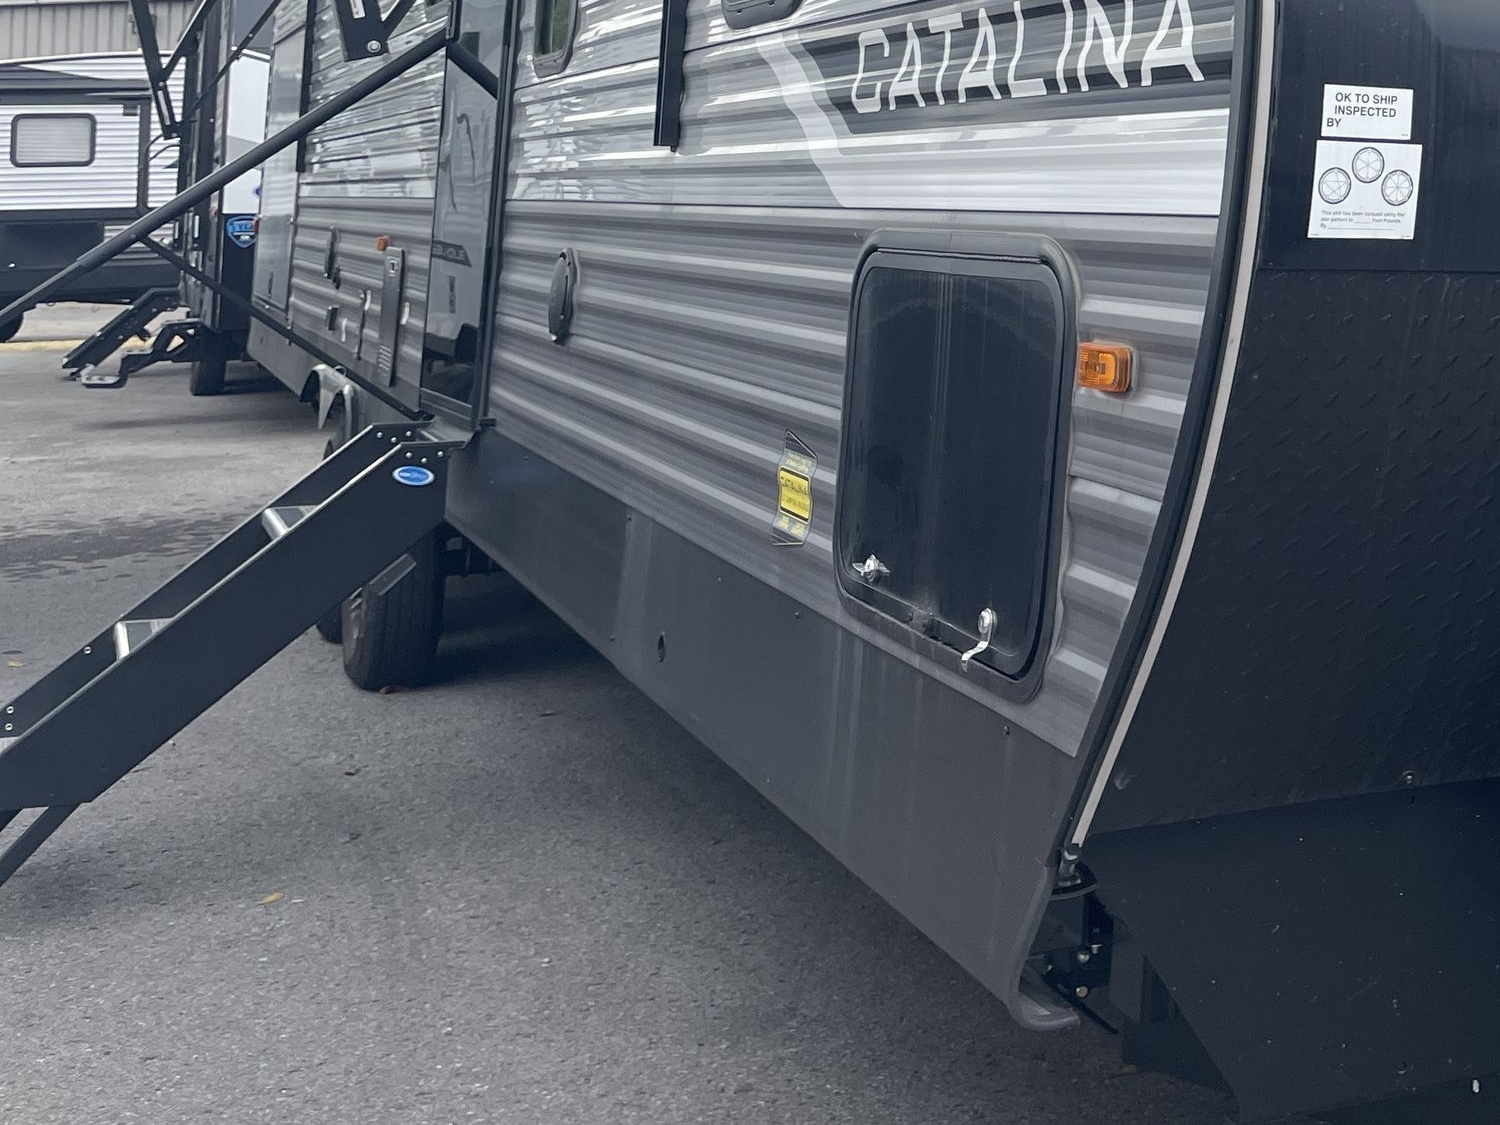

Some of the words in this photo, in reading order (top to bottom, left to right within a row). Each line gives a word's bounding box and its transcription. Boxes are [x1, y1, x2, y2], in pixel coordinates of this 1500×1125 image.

[1335, 92, 1352, 103] OK
[1355, 93, 1370, 104] TO
[1373, 94, 1398, 105] SHIP
[1334, 105, 1397, 118] INSPECTED
[1326, 118, 1342, 127] BY
